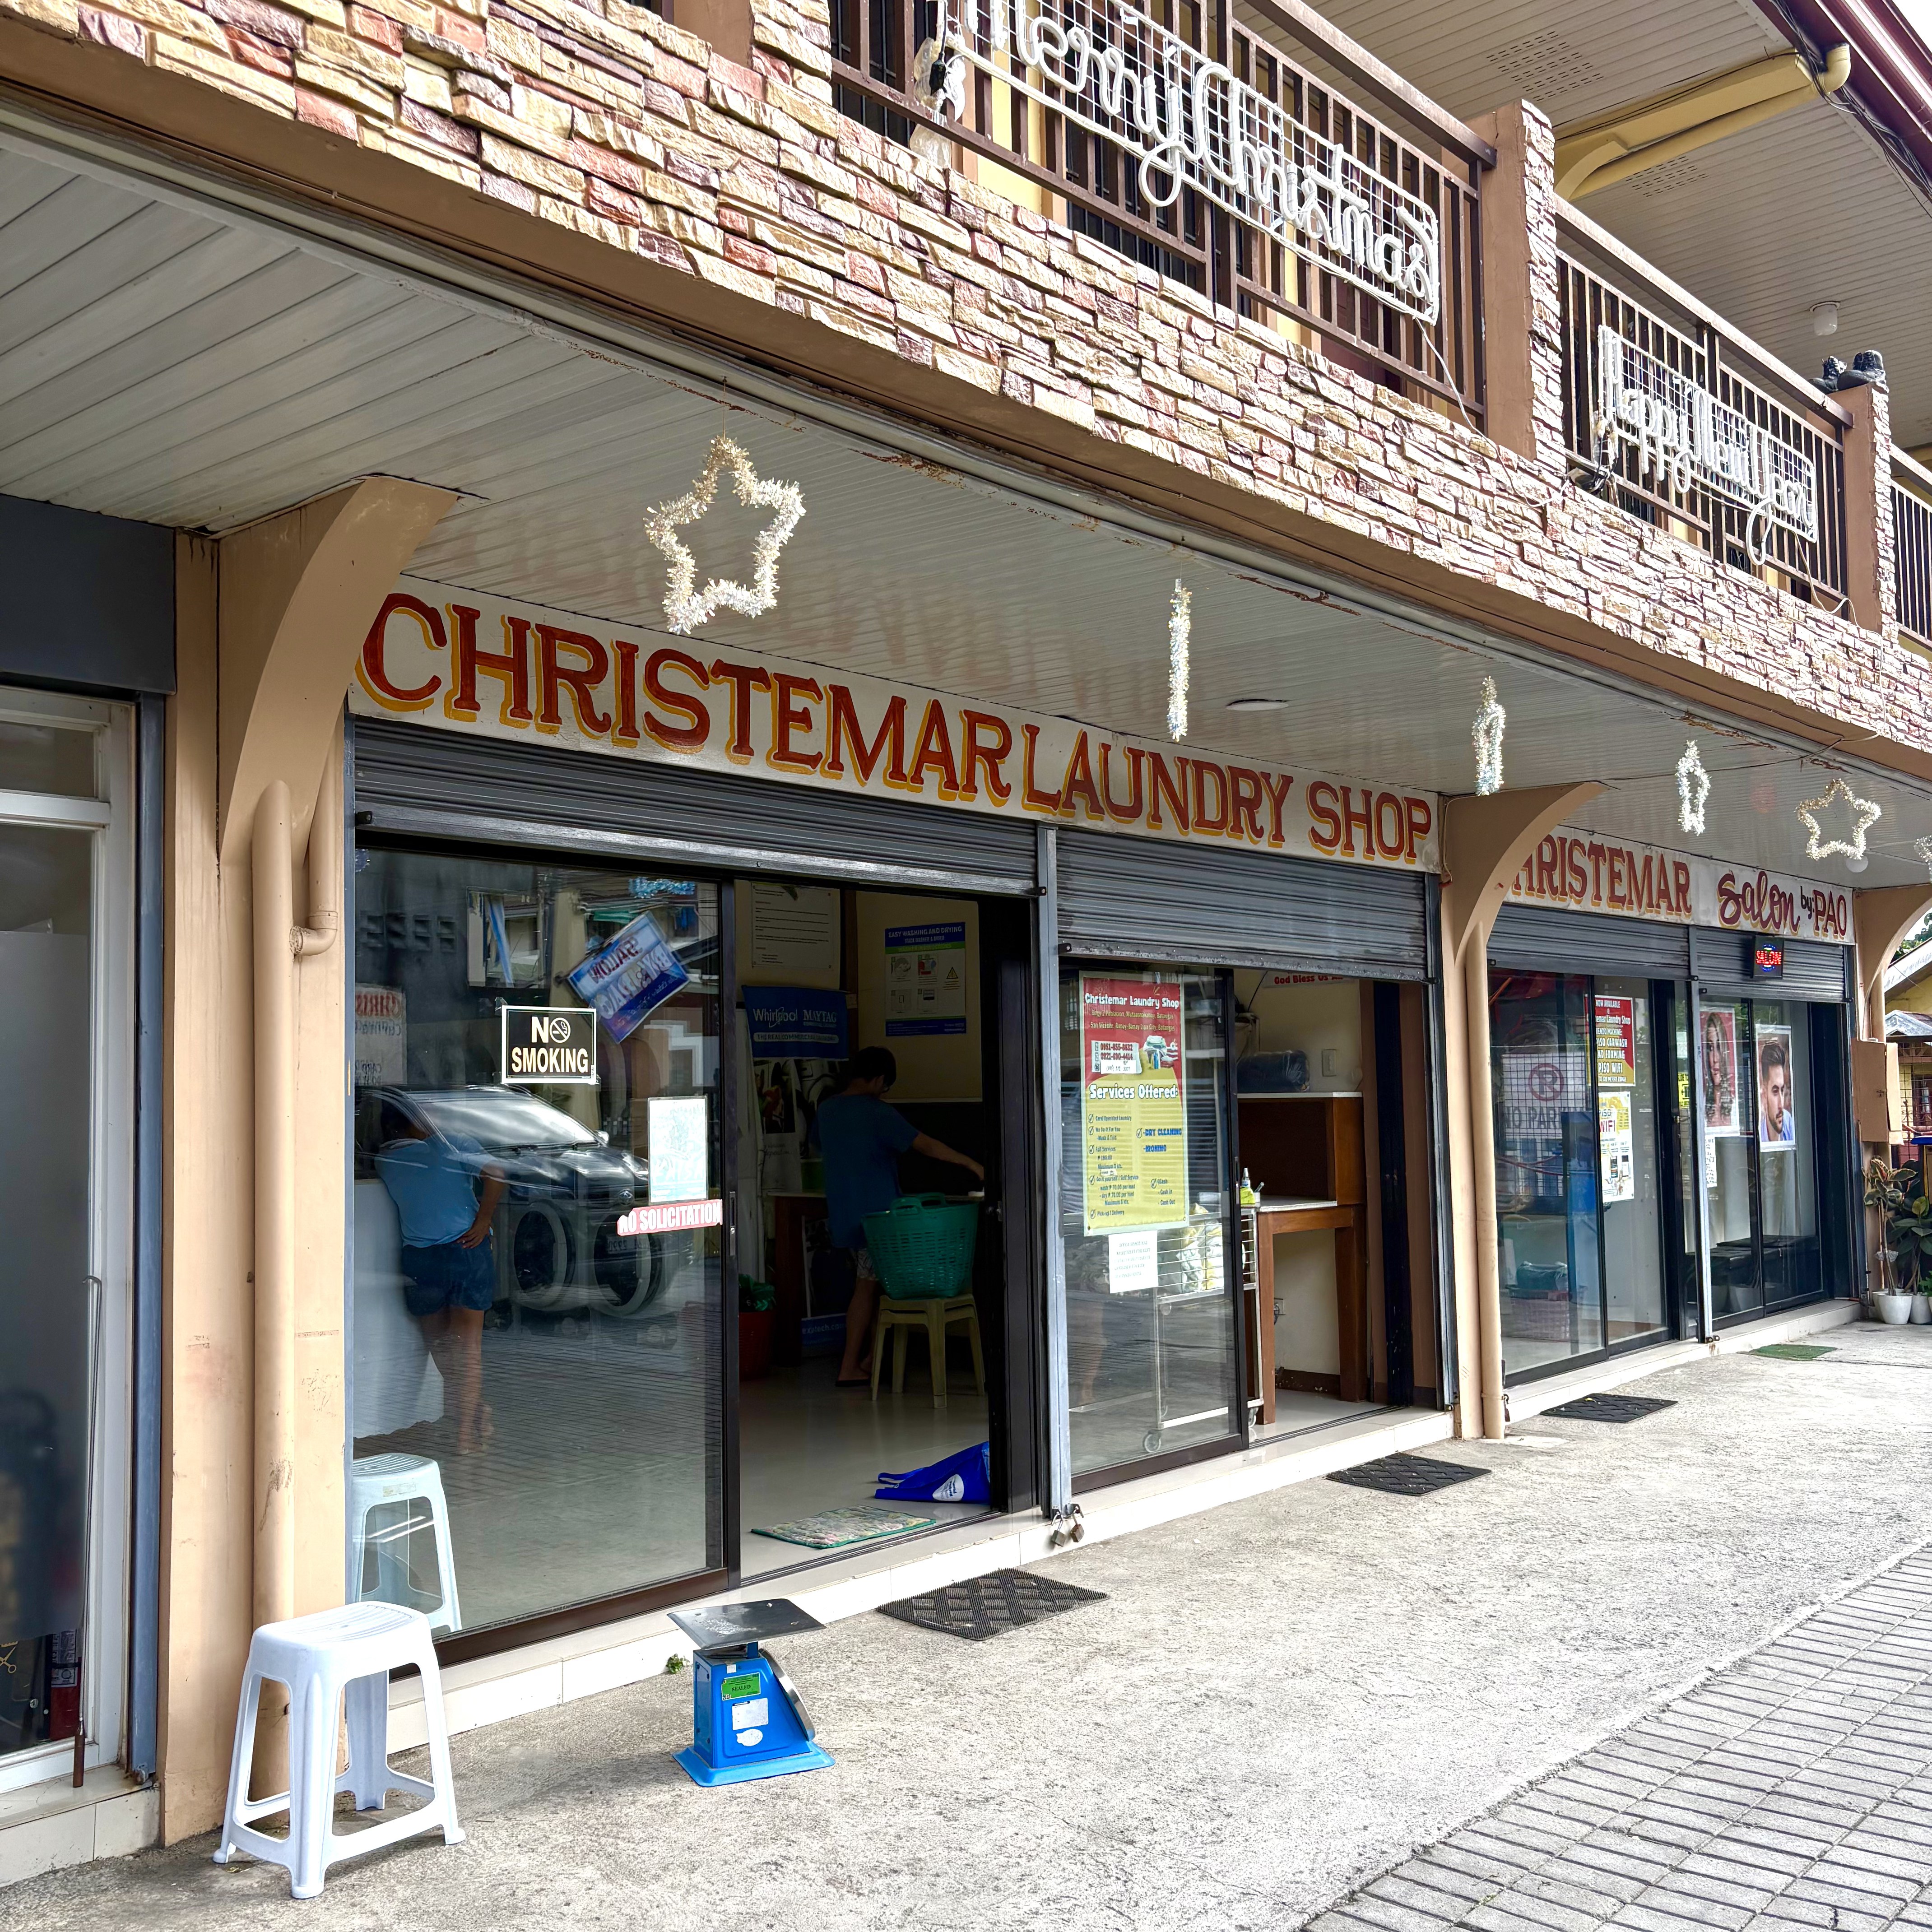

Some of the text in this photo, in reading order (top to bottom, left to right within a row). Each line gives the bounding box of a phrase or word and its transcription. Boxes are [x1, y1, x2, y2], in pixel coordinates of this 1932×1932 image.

[1192, 62, 1435, 302] Christmas
[1598, 325, 1693, 493] Happy
[1692, 388, 1750, 487] New
[356, 592, 1431, 865] CHRISTEMAR LAUNDRY SHOP
[1511, 834, 1693, 920] HRISTEMAR
[1717, 869, 1801, 935] Salon
[1813, 889, 1847, 939] PAO
[1756, 950, 1782, 965] SALON
[1274, 975, 1291, 985] God
[1293, 975, 1315, 983] Bless
[1085, 993, 1180, 1009] Christemar Laundry Shop
[752, 1007, 837, 1028] Whirlpool MAYTAG
[1607, 1038, 1627, 1048] CARWASH
[511, 1047, 588, 1073] SMOKING
[1605, 1050, 1625, 1059] FOAMING
[1598, 1062, 1622, 1073] PISO WIFI
[1089, 1083, 1179, 1099] Services Offered:
[619, 1202, 721, 1233] NO SOLICITATION
